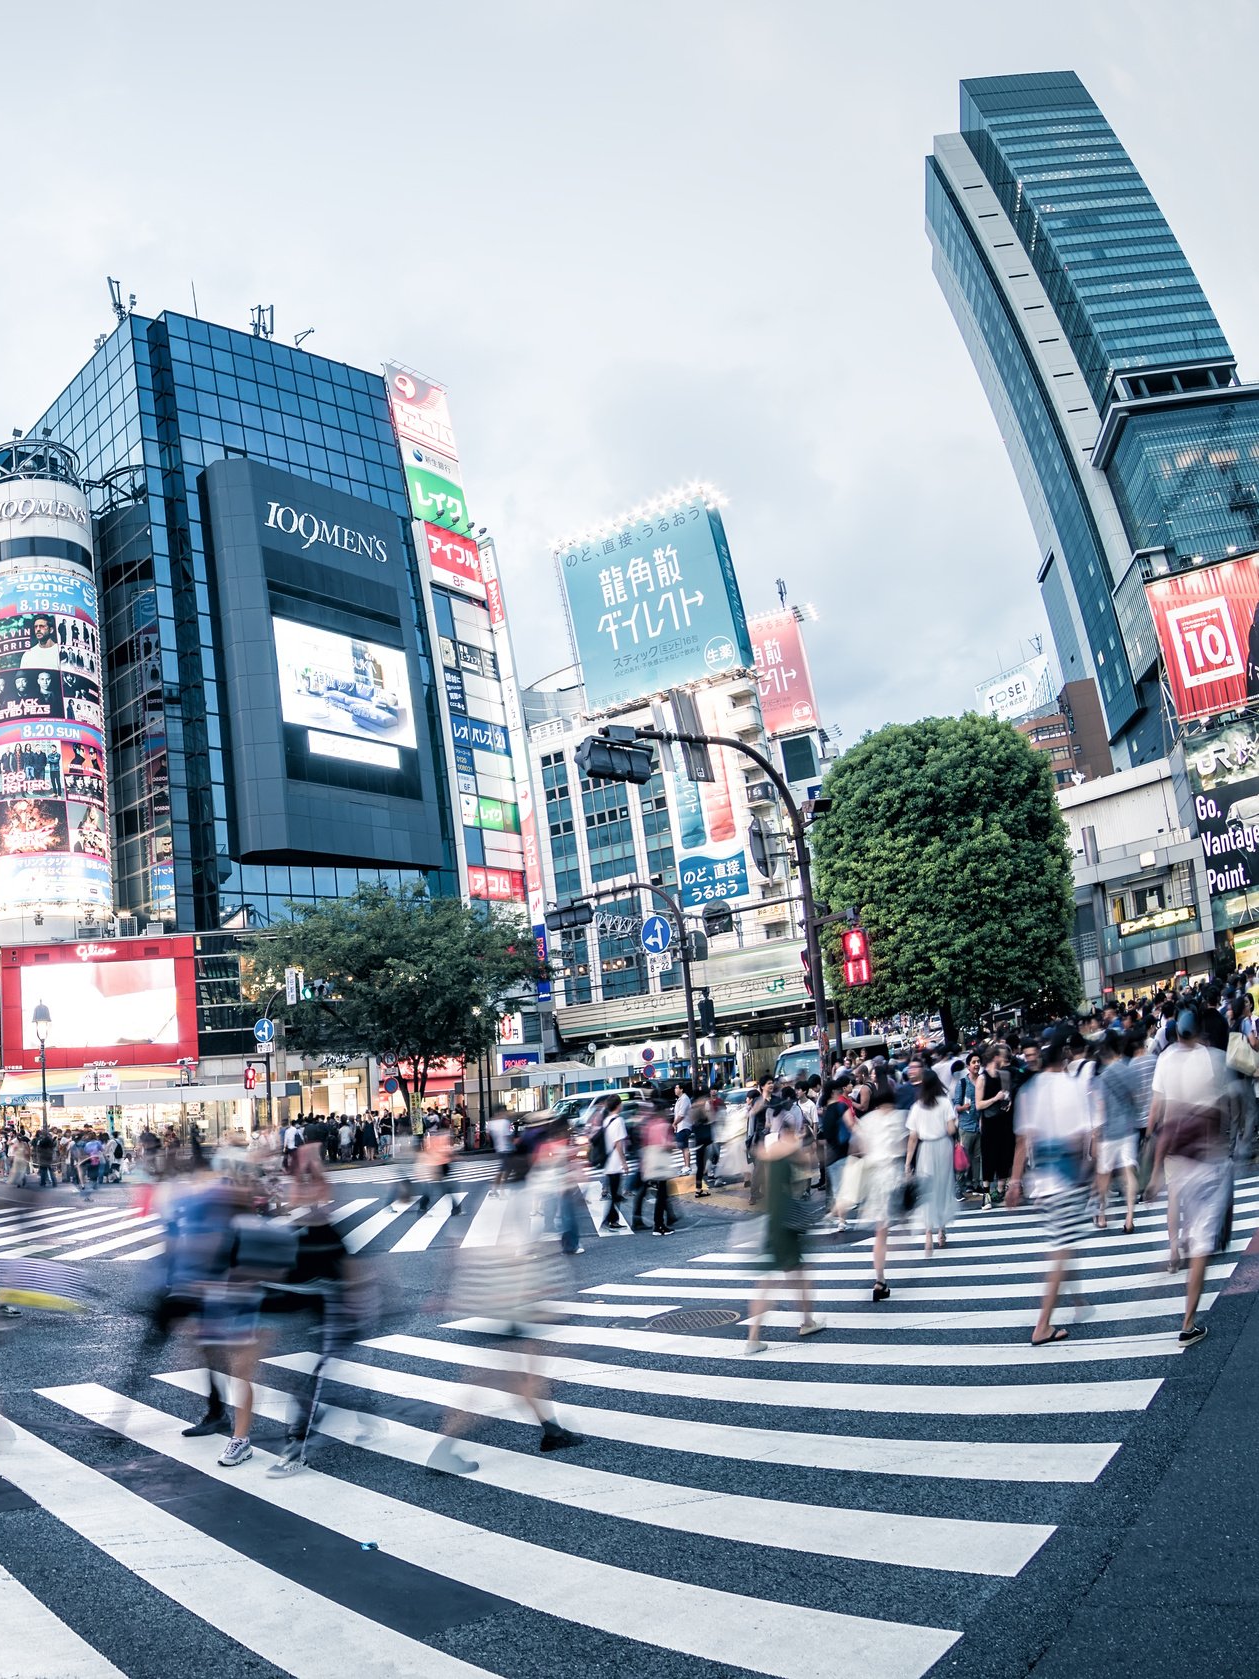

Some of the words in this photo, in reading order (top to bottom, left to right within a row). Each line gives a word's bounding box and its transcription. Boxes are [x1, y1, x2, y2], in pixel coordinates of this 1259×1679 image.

[425, 455, 451, 475] 新生銀行
[414, 480, 463, 520] レイク
[427, 533, 479, 571] アイフル
[7, 574, 81, 588] SUMMER
[453, 575, 465, 588] 8F
[598, 544, 683, 608] 龍角散
[16, 582, 75, 595] SONIC
[20, 598, 50, 611] 8.19
[52, 602, 73, 613] SAT
[597, 587, 705, 651] ダイレクト
[706, 644, 733, 664] 生薬
[989, 681, 1027, 706] TOSEI
[24, 704, 51, 716] PEAS
[22, 725, 54, 737] 8.20
[56, 728, 80, 739] SUN
[2, 771, 26, 784] FOO
[479, 806, 502, 822] レイク
[1196, 795, 1222, 821] Go,
[525, 835, 537, 867] アコム
[683, 859, 746, 885] のど、直接、
[1207, 863, 1251, 894] Point.
[472, 873, 509, 894] アコム
[691, 881, 739, 901] うるおう
[76, 944, 116, 961] Glico
[767, 979, 785, 991] JR
